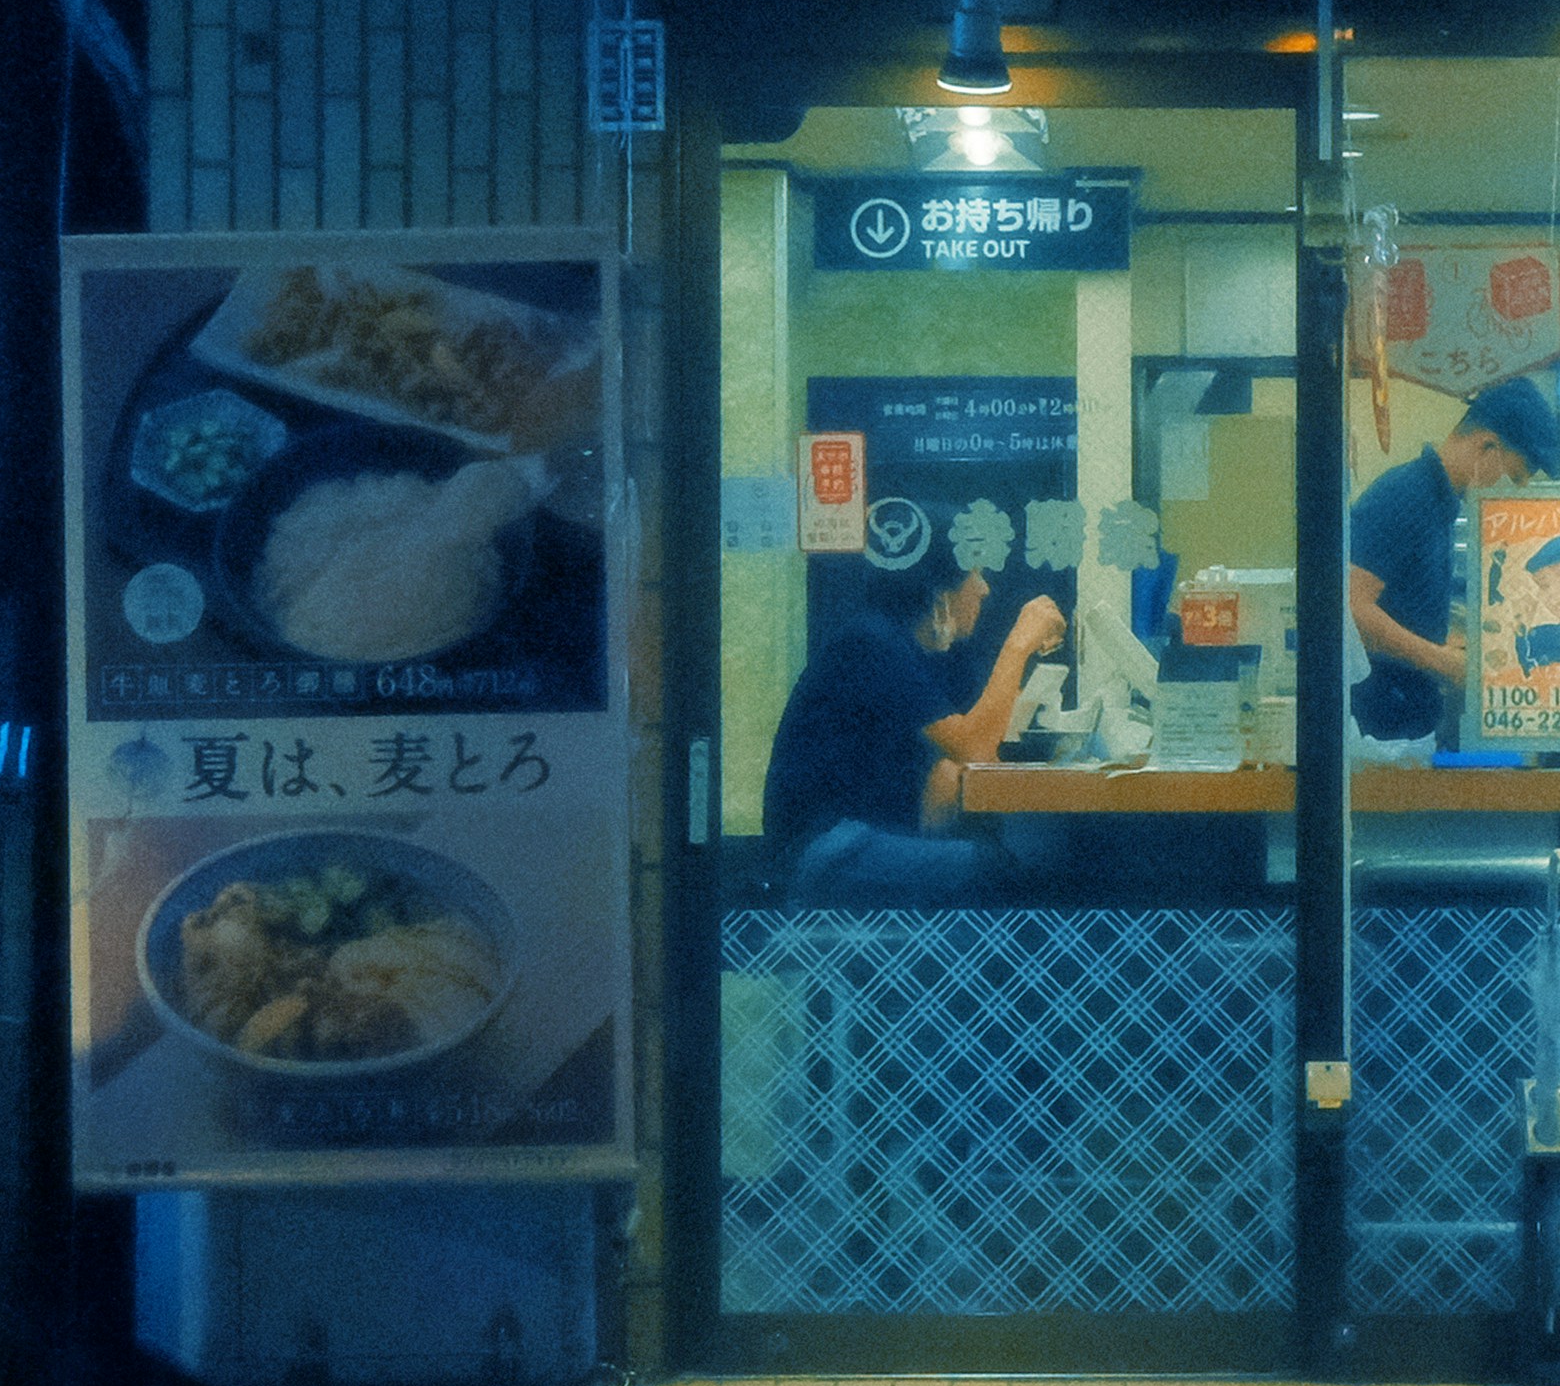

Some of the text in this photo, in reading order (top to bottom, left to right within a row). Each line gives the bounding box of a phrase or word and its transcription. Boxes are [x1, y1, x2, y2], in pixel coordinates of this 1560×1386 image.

[920, 198, 1094, 235] お持ち帰り
[920, 239, 1031, 259] TAKE OUT
[1486, 687, 1537, 707] 1100
[181, 730, 553, 803] 夏は、麦とろ
